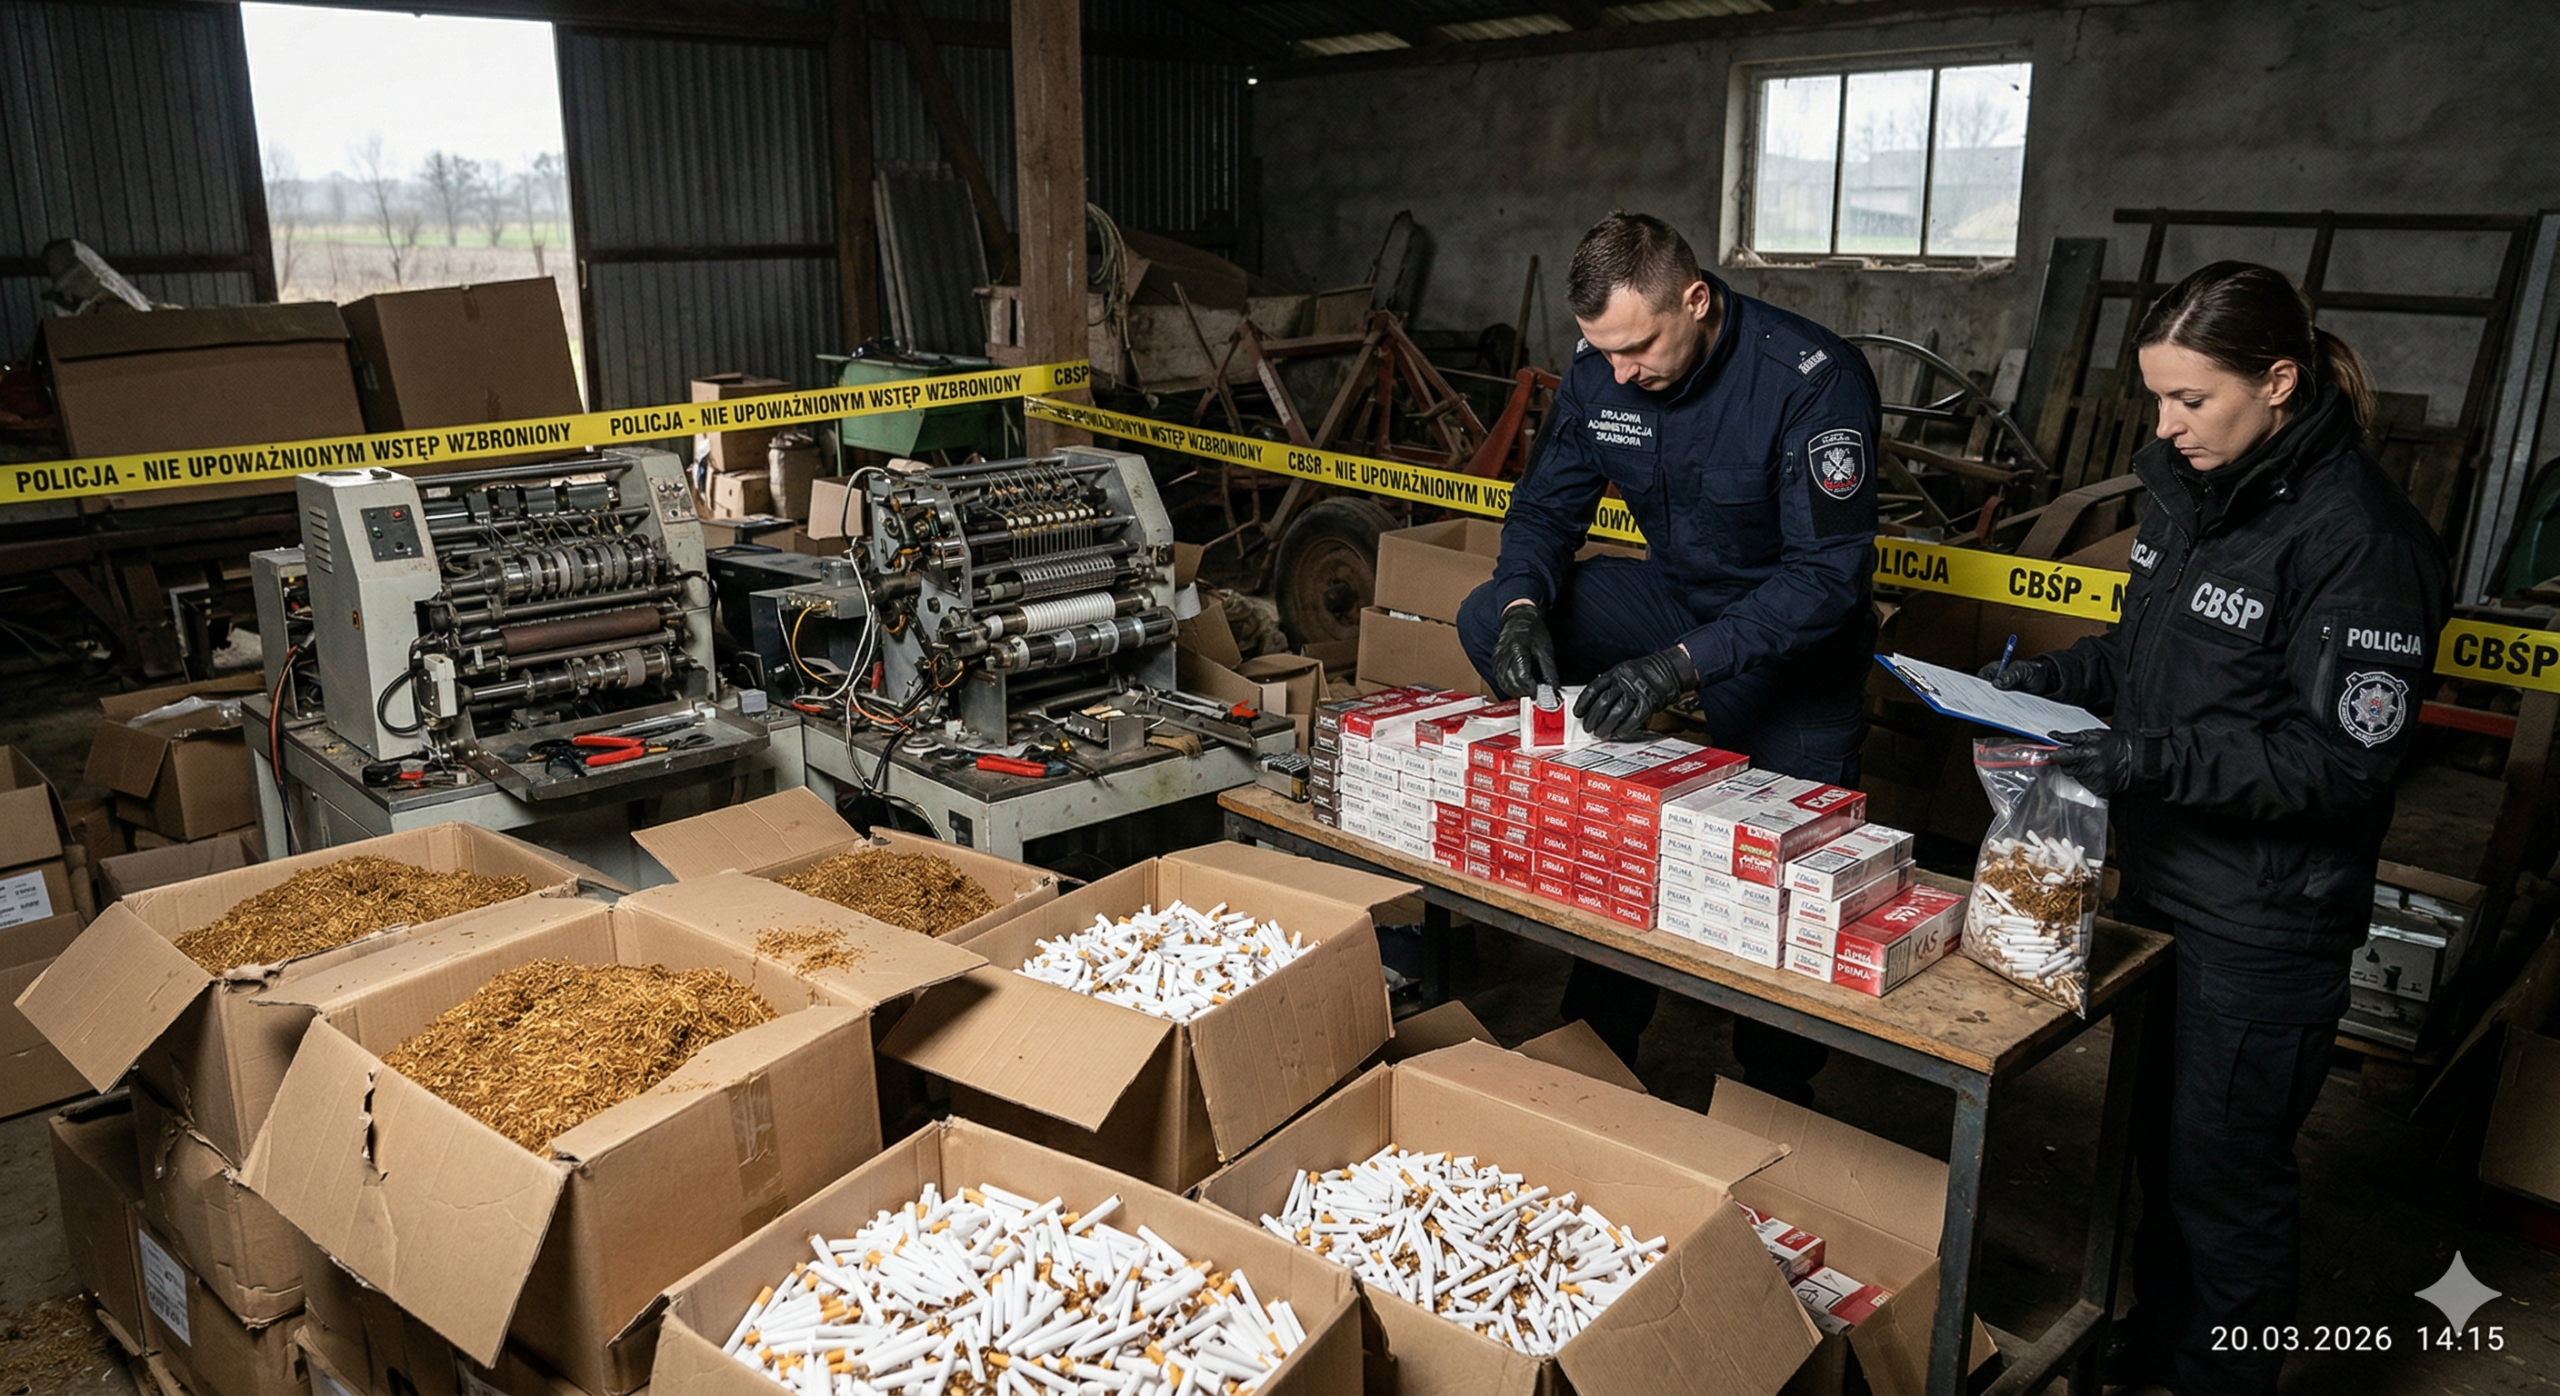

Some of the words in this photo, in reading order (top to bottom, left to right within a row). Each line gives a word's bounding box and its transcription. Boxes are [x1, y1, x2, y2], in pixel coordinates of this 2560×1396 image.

[17, 466, 118, 494] POLICJA
[143, 458, 181, 484] NIE
[188, 445, 366, 478] UPOWAŻNIONYM
[371, 436, 441, 463] WSTĘP
[446, 422, 571, 454] WZBRONIONY
[610, 412, 683, 437] POLICJA
[701, 406, 728, 426] NIE
[733, 391, 865, 423] UPOWAŻNIONYM
[869, 385, 921, 410] WSTĘP
[925, 374, 1022, 401] WZBRONIONY
[1149, 425, 1186, 449] WSTĘP
[1188, 432, 1263, 463] WZBRONIONY
[1335, 460, 1357, 481] NIE
[1361, 467, 1478, 505] UPOWAŻNIONYM
[2009, 566, 2082, 604] CBŚP
[2190, 582, 2264, 630] CBŚP
[2347, 627, 2422, 656] POLICJA
[2453, 632, 2559, 678] CBŚP
